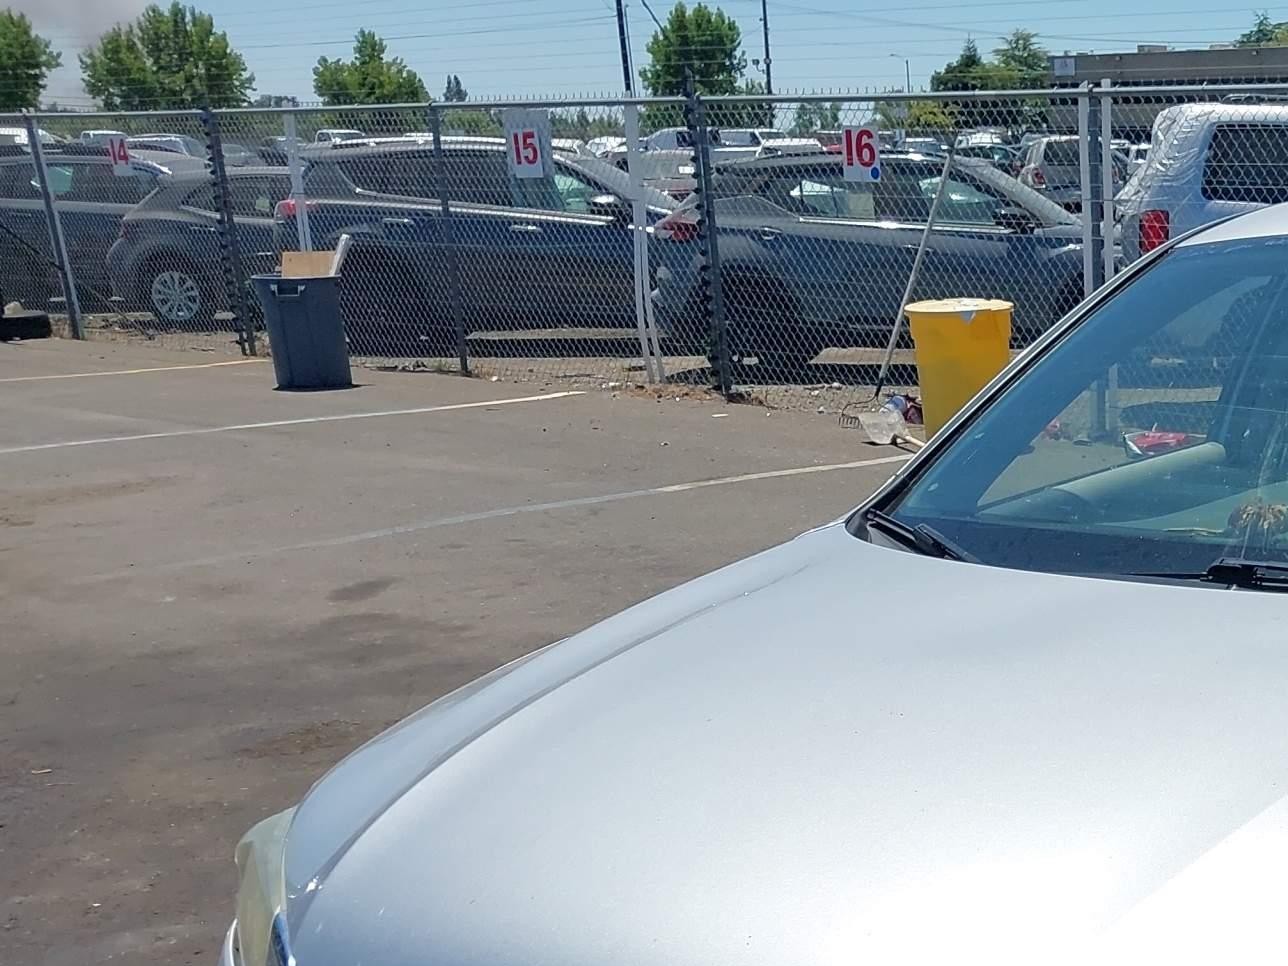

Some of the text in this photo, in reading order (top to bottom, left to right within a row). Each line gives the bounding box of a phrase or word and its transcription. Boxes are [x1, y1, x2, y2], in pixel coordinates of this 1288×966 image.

[109, 138, 129, 166] 14
[512, 130, 539, 166] 15
[844, 128, 876, 168] 16
